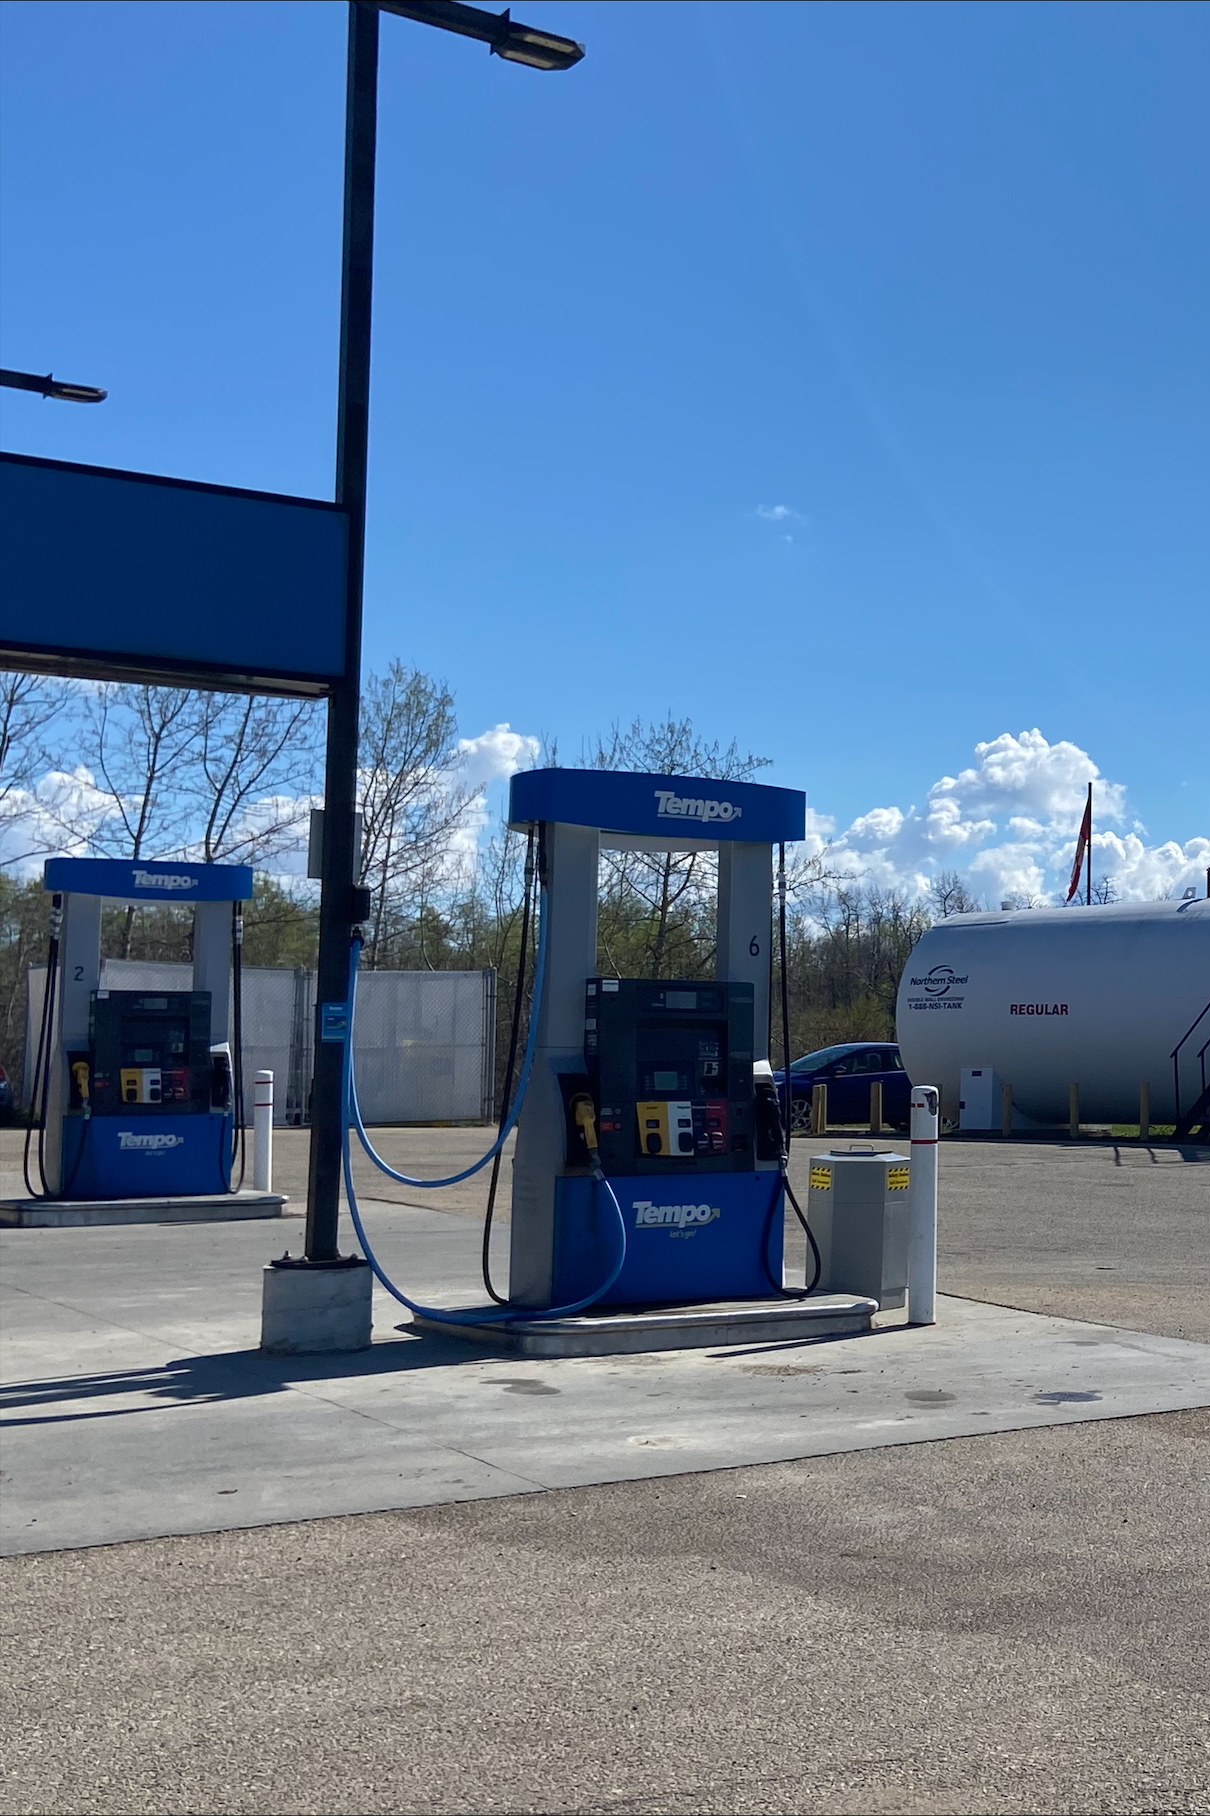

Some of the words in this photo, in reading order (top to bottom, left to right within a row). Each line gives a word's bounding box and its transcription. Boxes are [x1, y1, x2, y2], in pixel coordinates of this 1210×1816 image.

[654, 790, 733, 822] Tempo
[132, 870, 192, 890] Tempo
[749, 935, 759, 957] 6
[74, 966, 84, 982] 2
[910, 976, 946, 986] Northern
[947, 975, 969, 985] Steel
[1010, 1004, 1069, 1015] REGULAR
[117, 1132, 177, 1149] Tempo
[632, 1201, 712, 1228] Tempo
